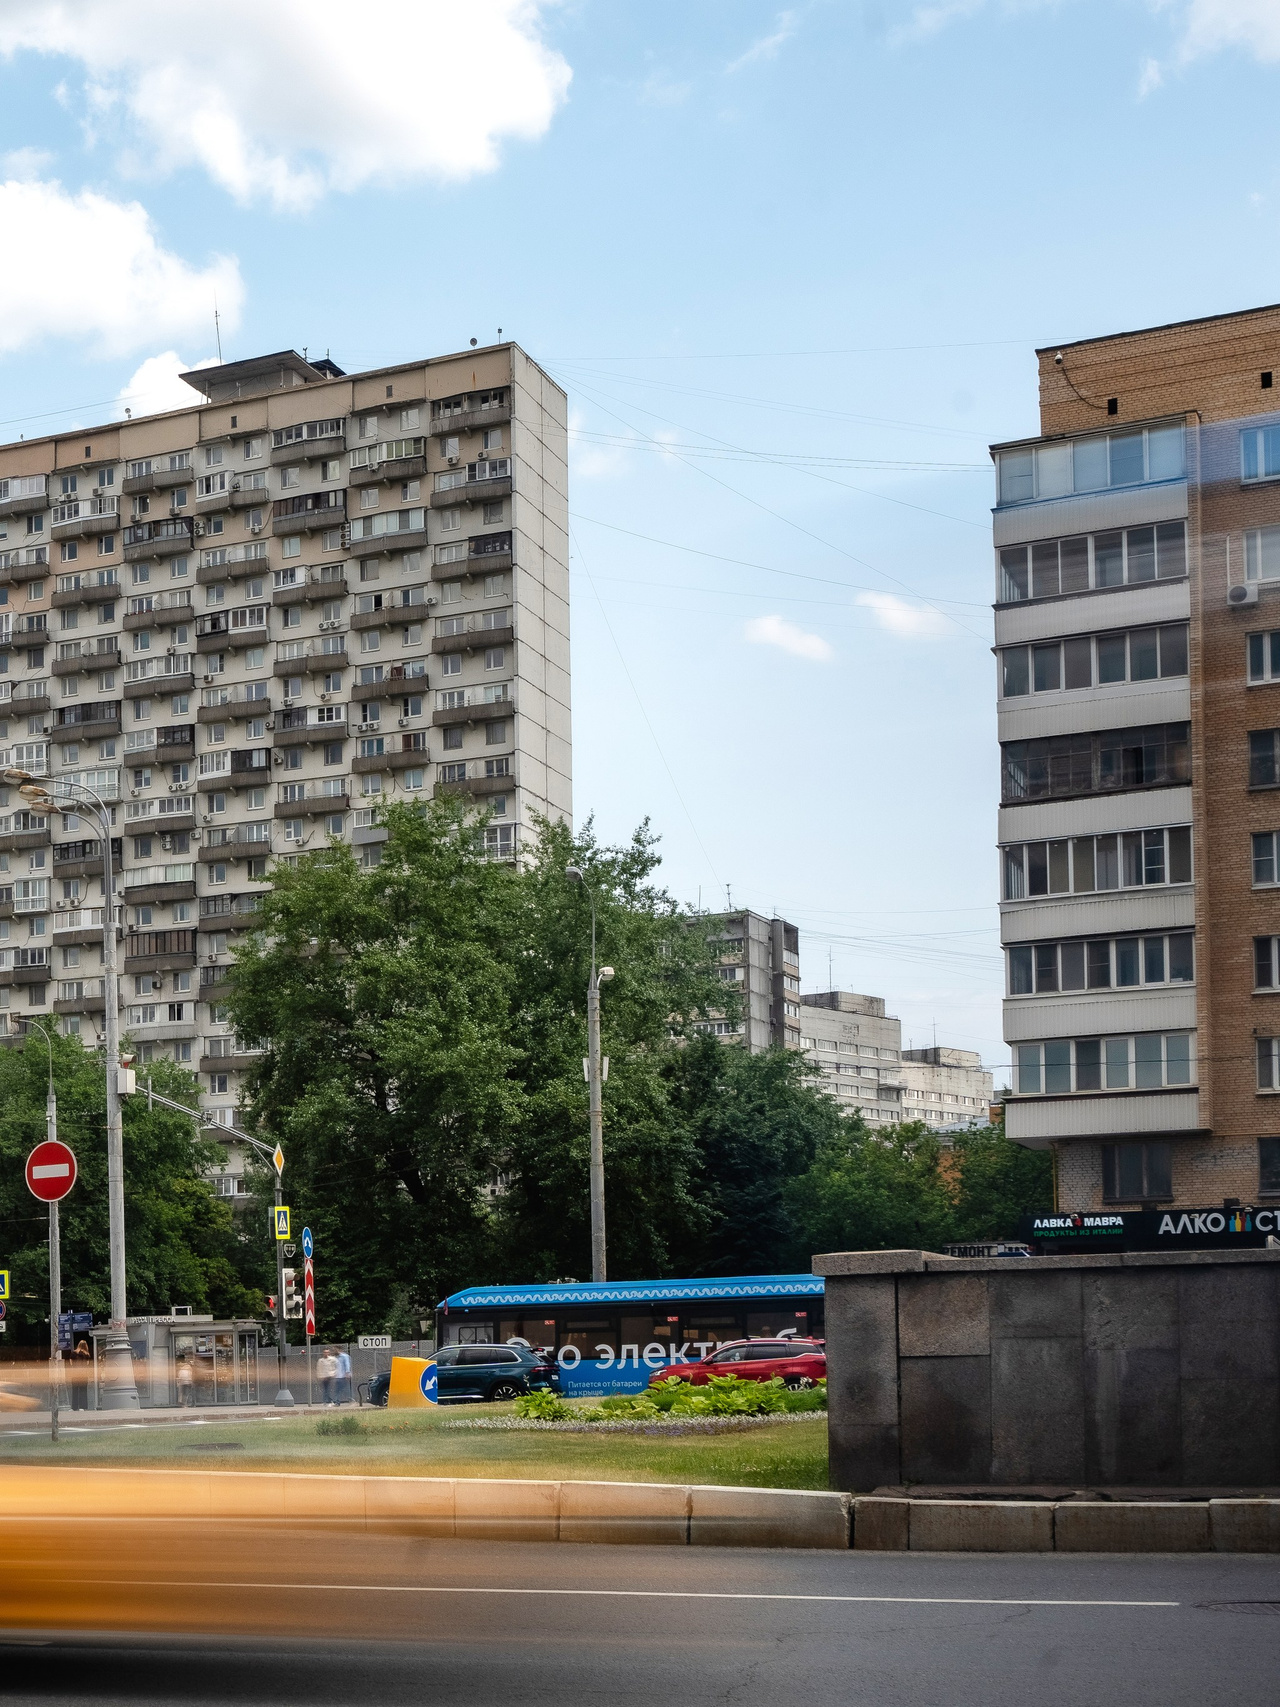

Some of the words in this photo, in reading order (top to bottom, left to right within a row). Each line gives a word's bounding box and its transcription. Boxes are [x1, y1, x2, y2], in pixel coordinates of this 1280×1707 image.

[1033, 1218, 1074, 1229] ЛАВКА
[1083, 1216, 1124, 1227] МАВРА
[1158, 1213, 1226, 1235] АЛКО
[1033, 1230, 1078, 1238] ПРОДУКТЫ
[1092, 1228, 1123, 1236] ИТАЛИИ
[362, 1337, 387, 1347] СТОП
[568, 1381, 601, 1389] Питается
[611, 1380, 643, 1388] батареи
[578, 1389, 604, 1397] крыше
